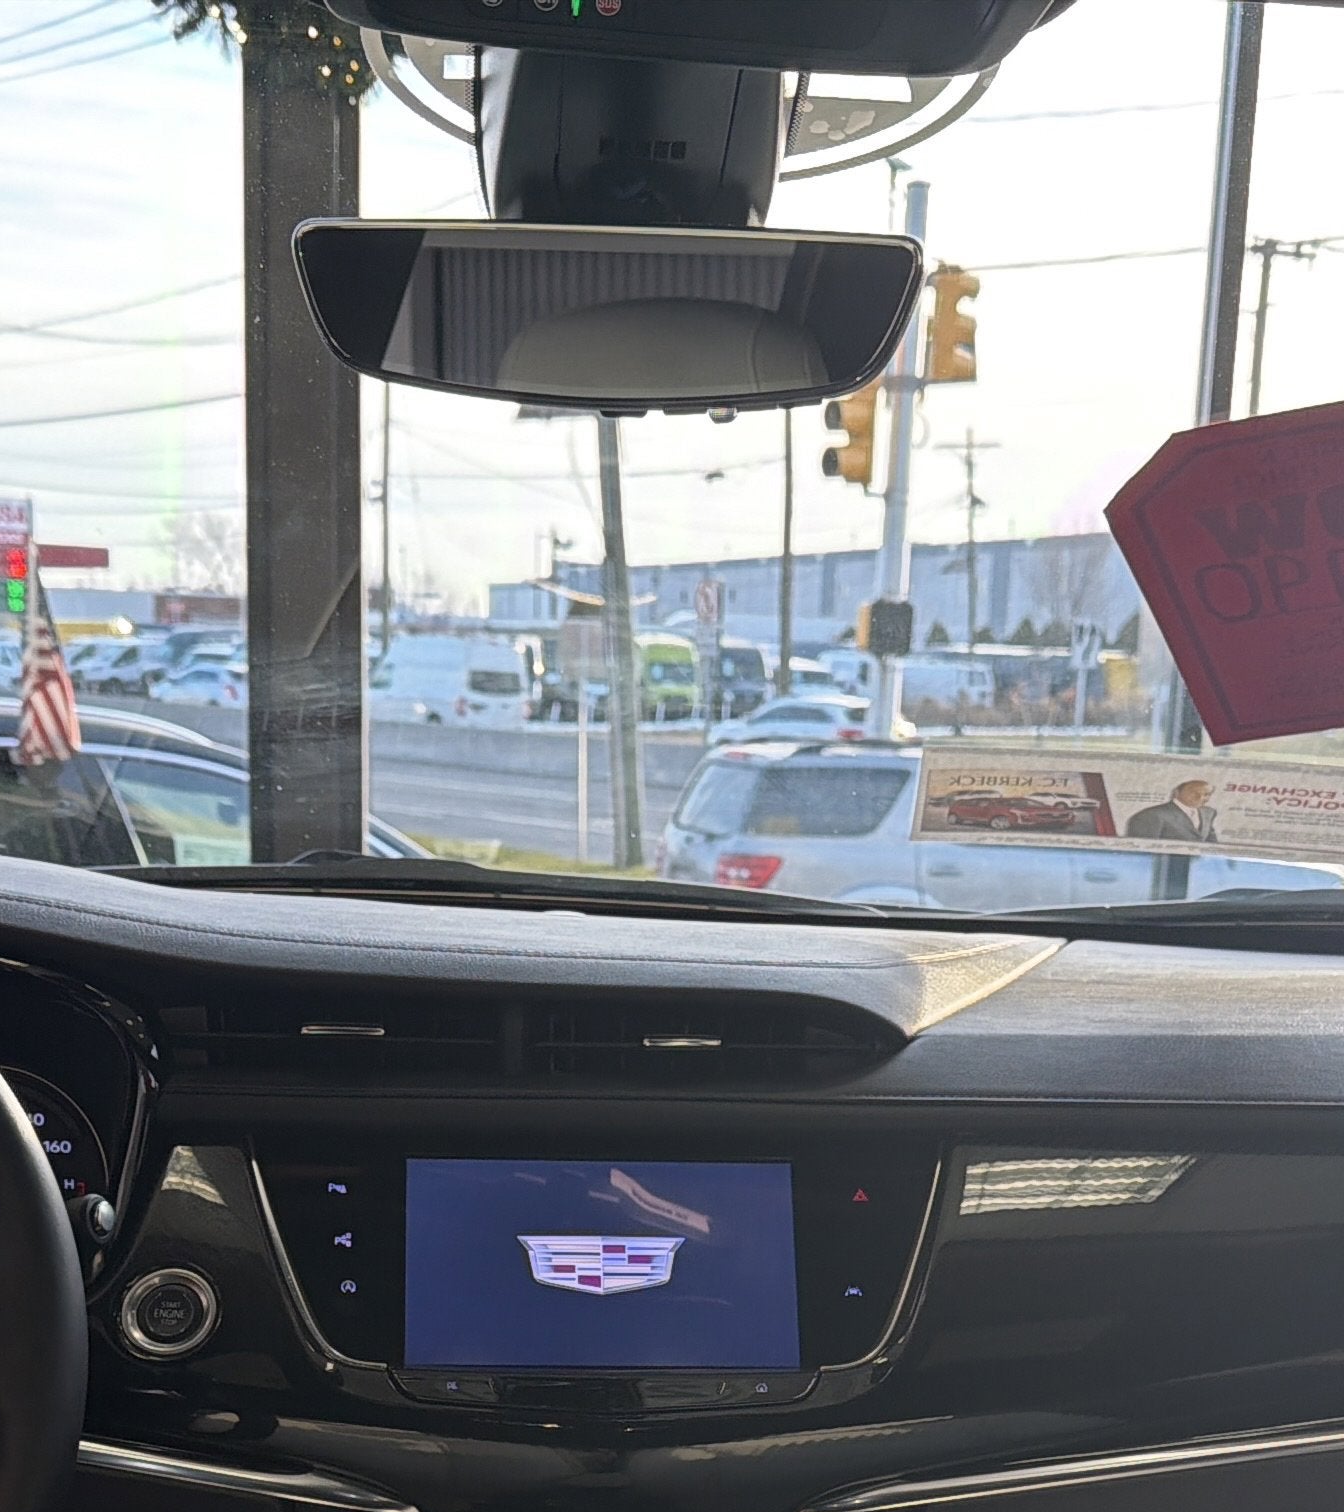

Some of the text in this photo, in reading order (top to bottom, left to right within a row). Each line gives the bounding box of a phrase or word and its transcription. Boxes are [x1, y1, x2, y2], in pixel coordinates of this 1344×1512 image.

[43, 1140, 71, 1154] 160
[64, 1178, 74, 1190] H
[154, 1308, 185, 1318] ENGINE
